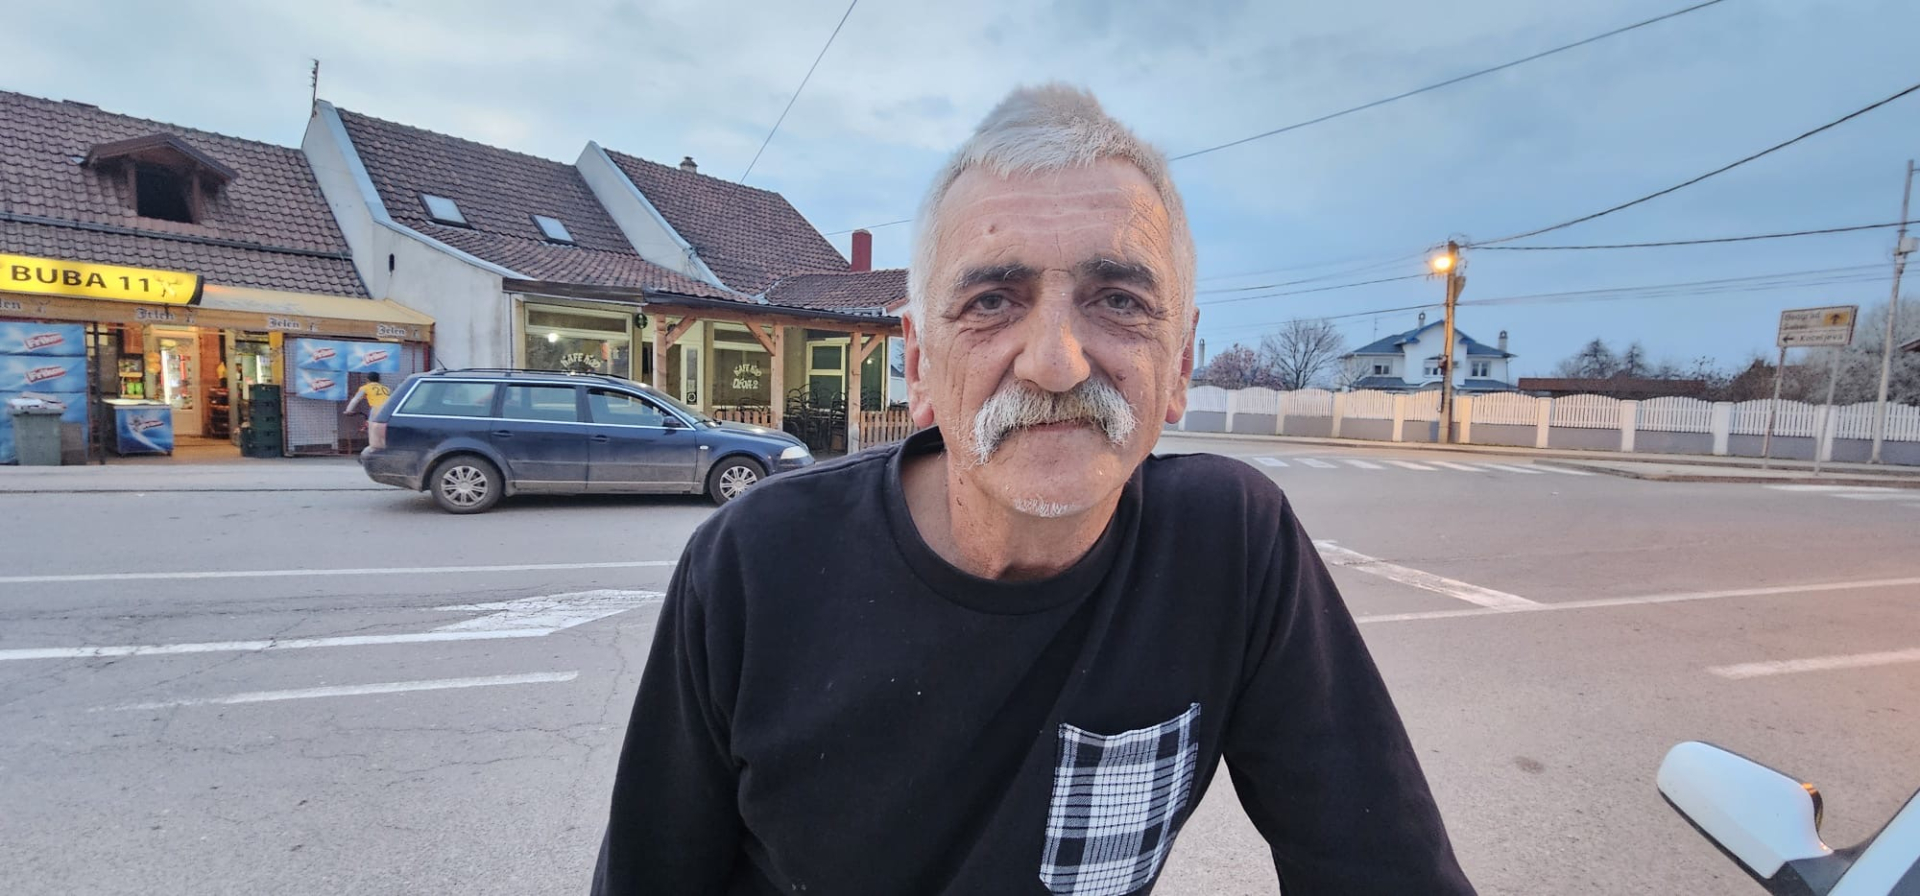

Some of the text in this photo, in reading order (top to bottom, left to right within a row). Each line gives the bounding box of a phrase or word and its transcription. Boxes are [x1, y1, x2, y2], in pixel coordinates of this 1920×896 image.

[11, 265, 150, 293] BUBA 11
[269, 317, 300, 329] Jelen
[377, 325, 406, 337] Jelen
[371, 386, 390, 397] 20
